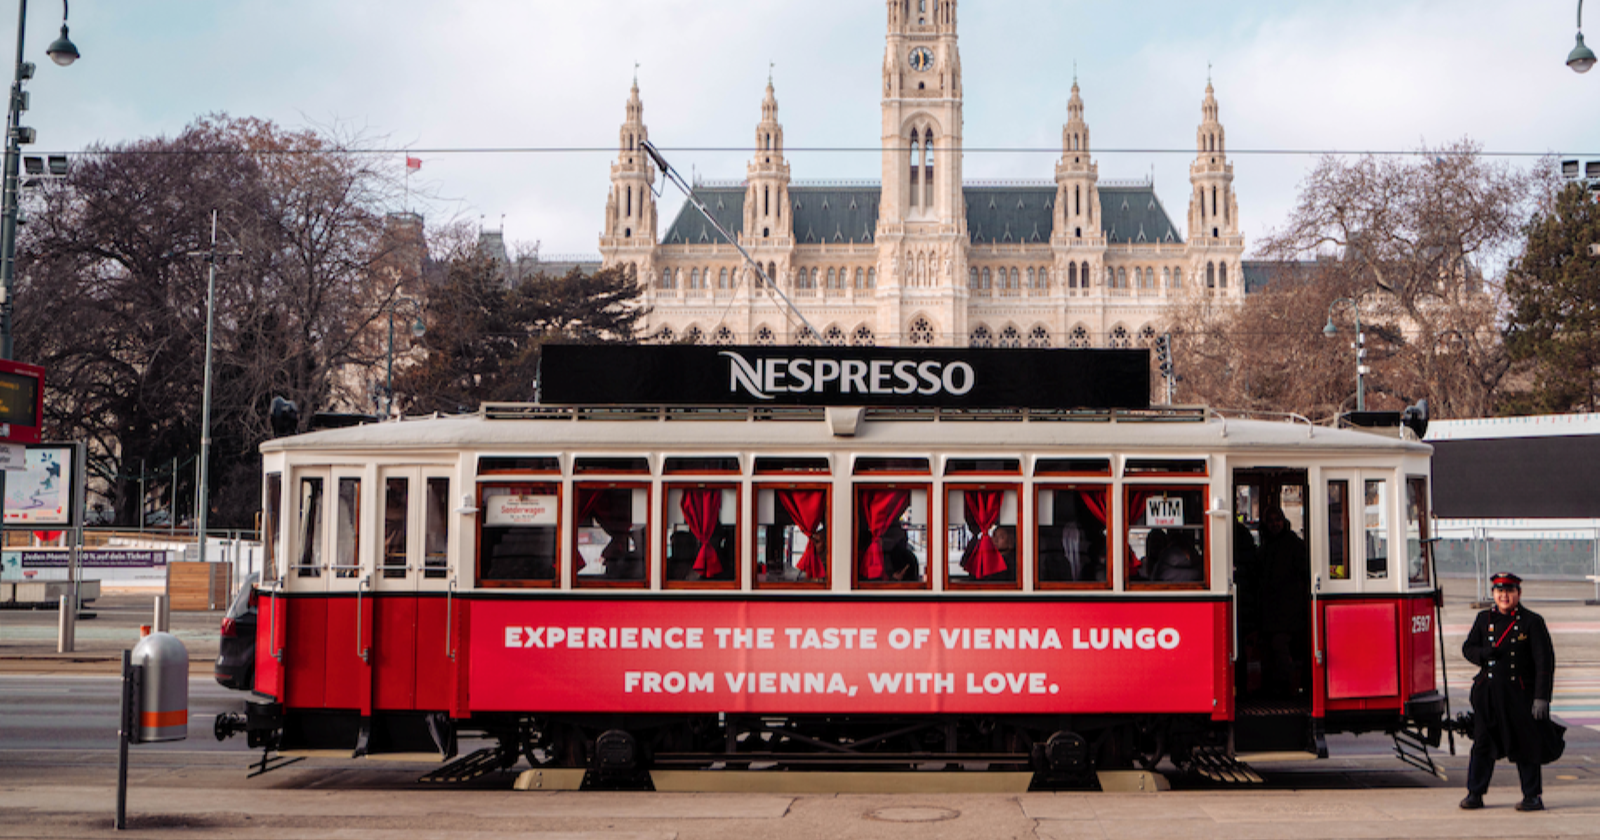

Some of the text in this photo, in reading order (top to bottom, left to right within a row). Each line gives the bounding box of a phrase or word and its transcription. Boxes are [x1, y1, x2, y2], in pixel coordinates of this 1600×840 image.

[718, 350, 975, 399] NESPRESSO
[501, 505, 545, 515] Sonderwagen
[1149, 501, 1180, 516] WTM
[24, 552, 45, 561] Jeden
[46, 552, 70, 561] Monta
[96, 552, 109, 561] auf
[109, 552, 125, 561] dein
[126, 552, 151, 561] Ticket!
[506, 628, 1180, 649] EXPERIENCE THE TASTE OF VIENNA LUNGO
[625, 672, 1059, 697] FROM VIENNA, WITH LOVE.
